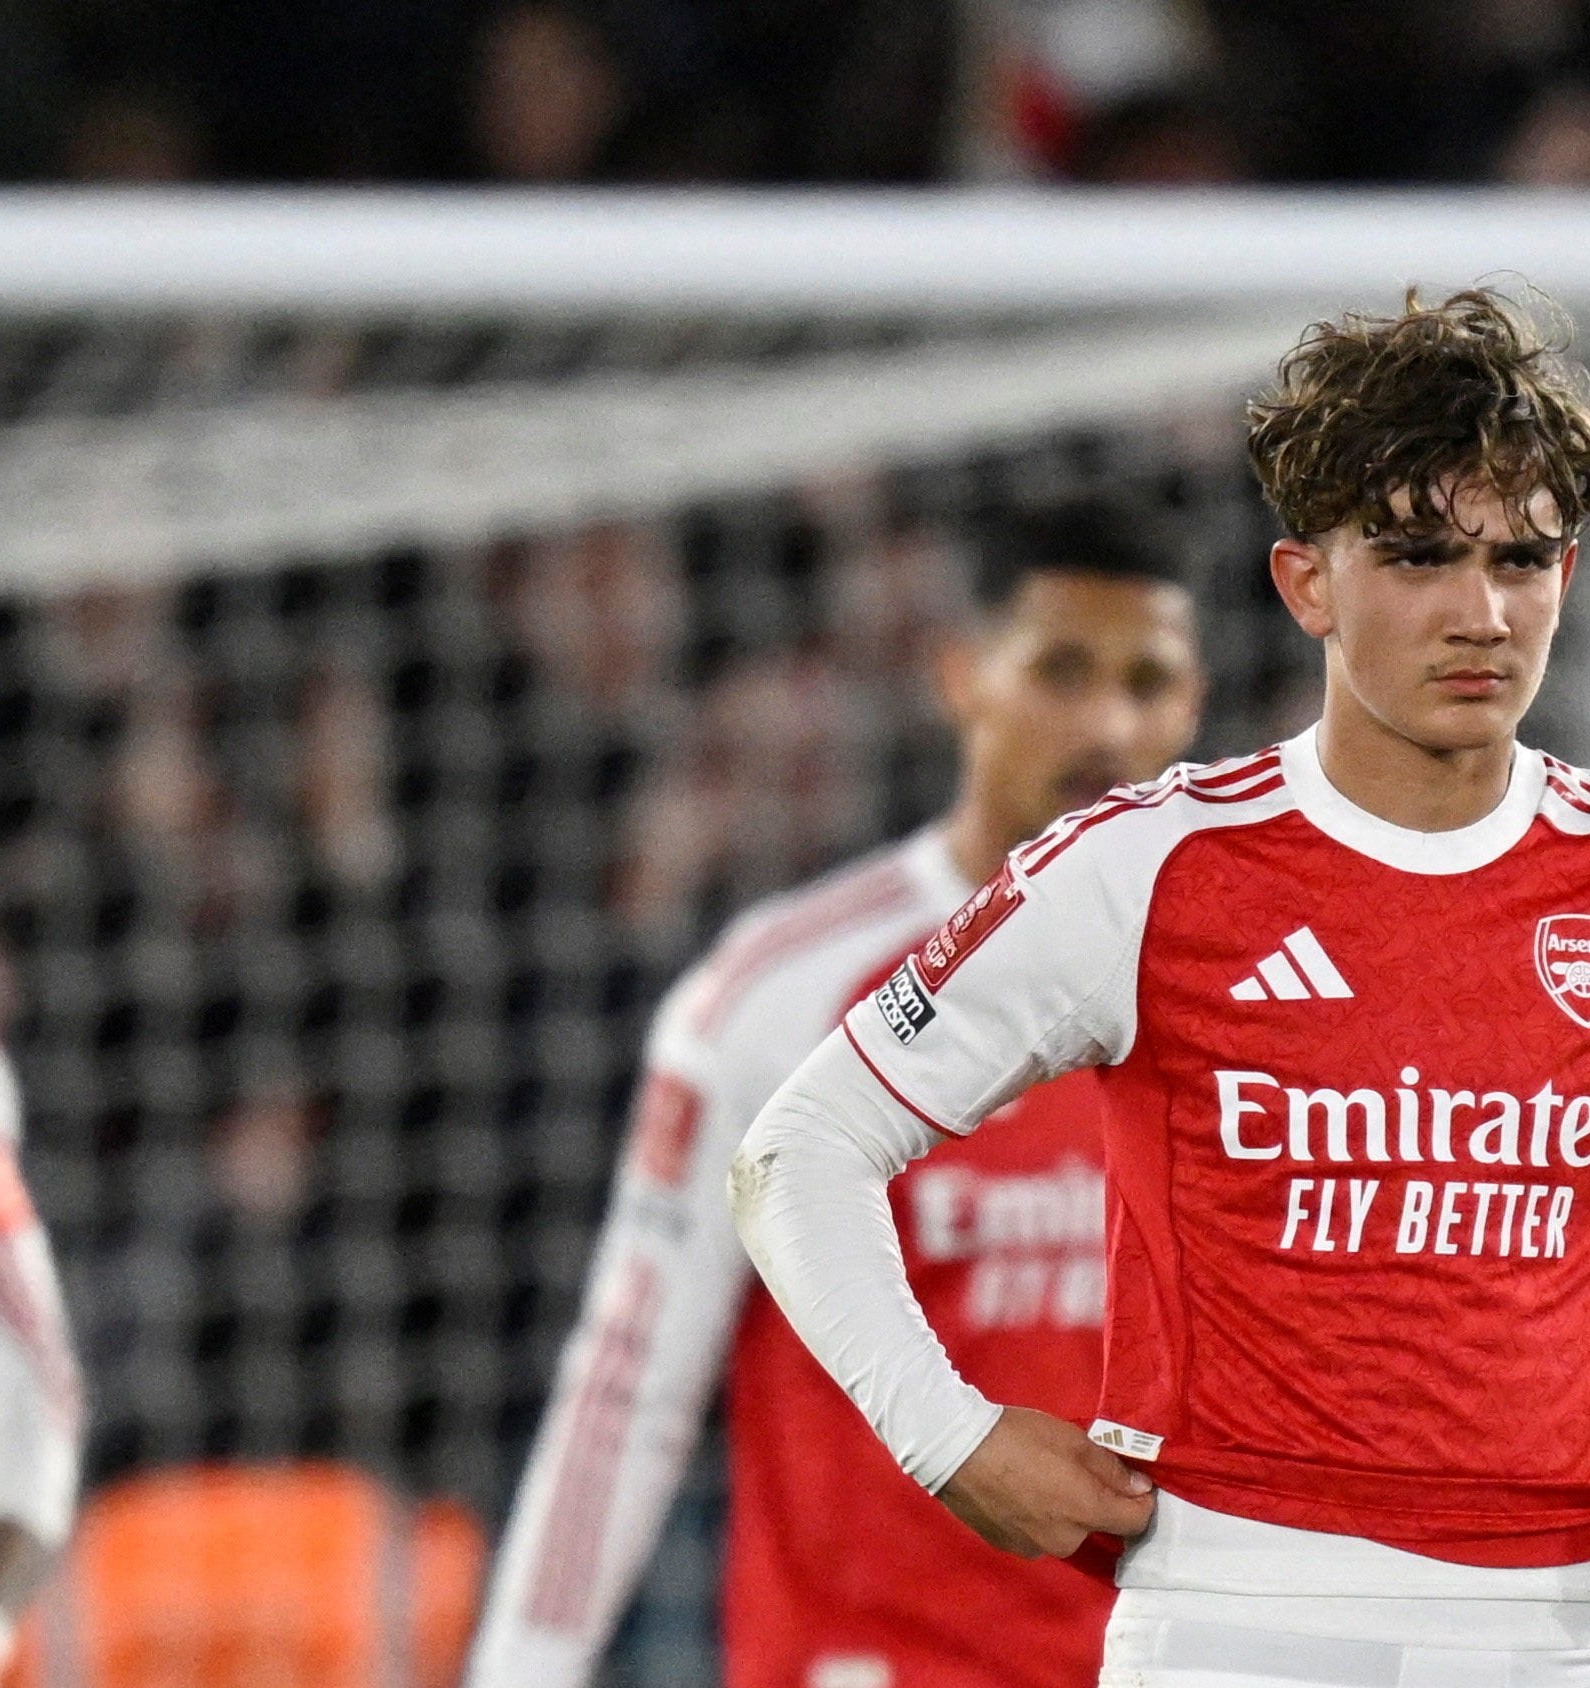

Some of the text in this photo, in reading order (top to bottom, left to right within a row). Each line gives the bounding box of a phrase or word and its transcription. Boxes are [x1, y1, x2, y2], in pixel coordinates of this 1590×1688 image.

[890, 972, 926, 1021] room
[1279, 1178, 1575, 1259] FLY BETTER
